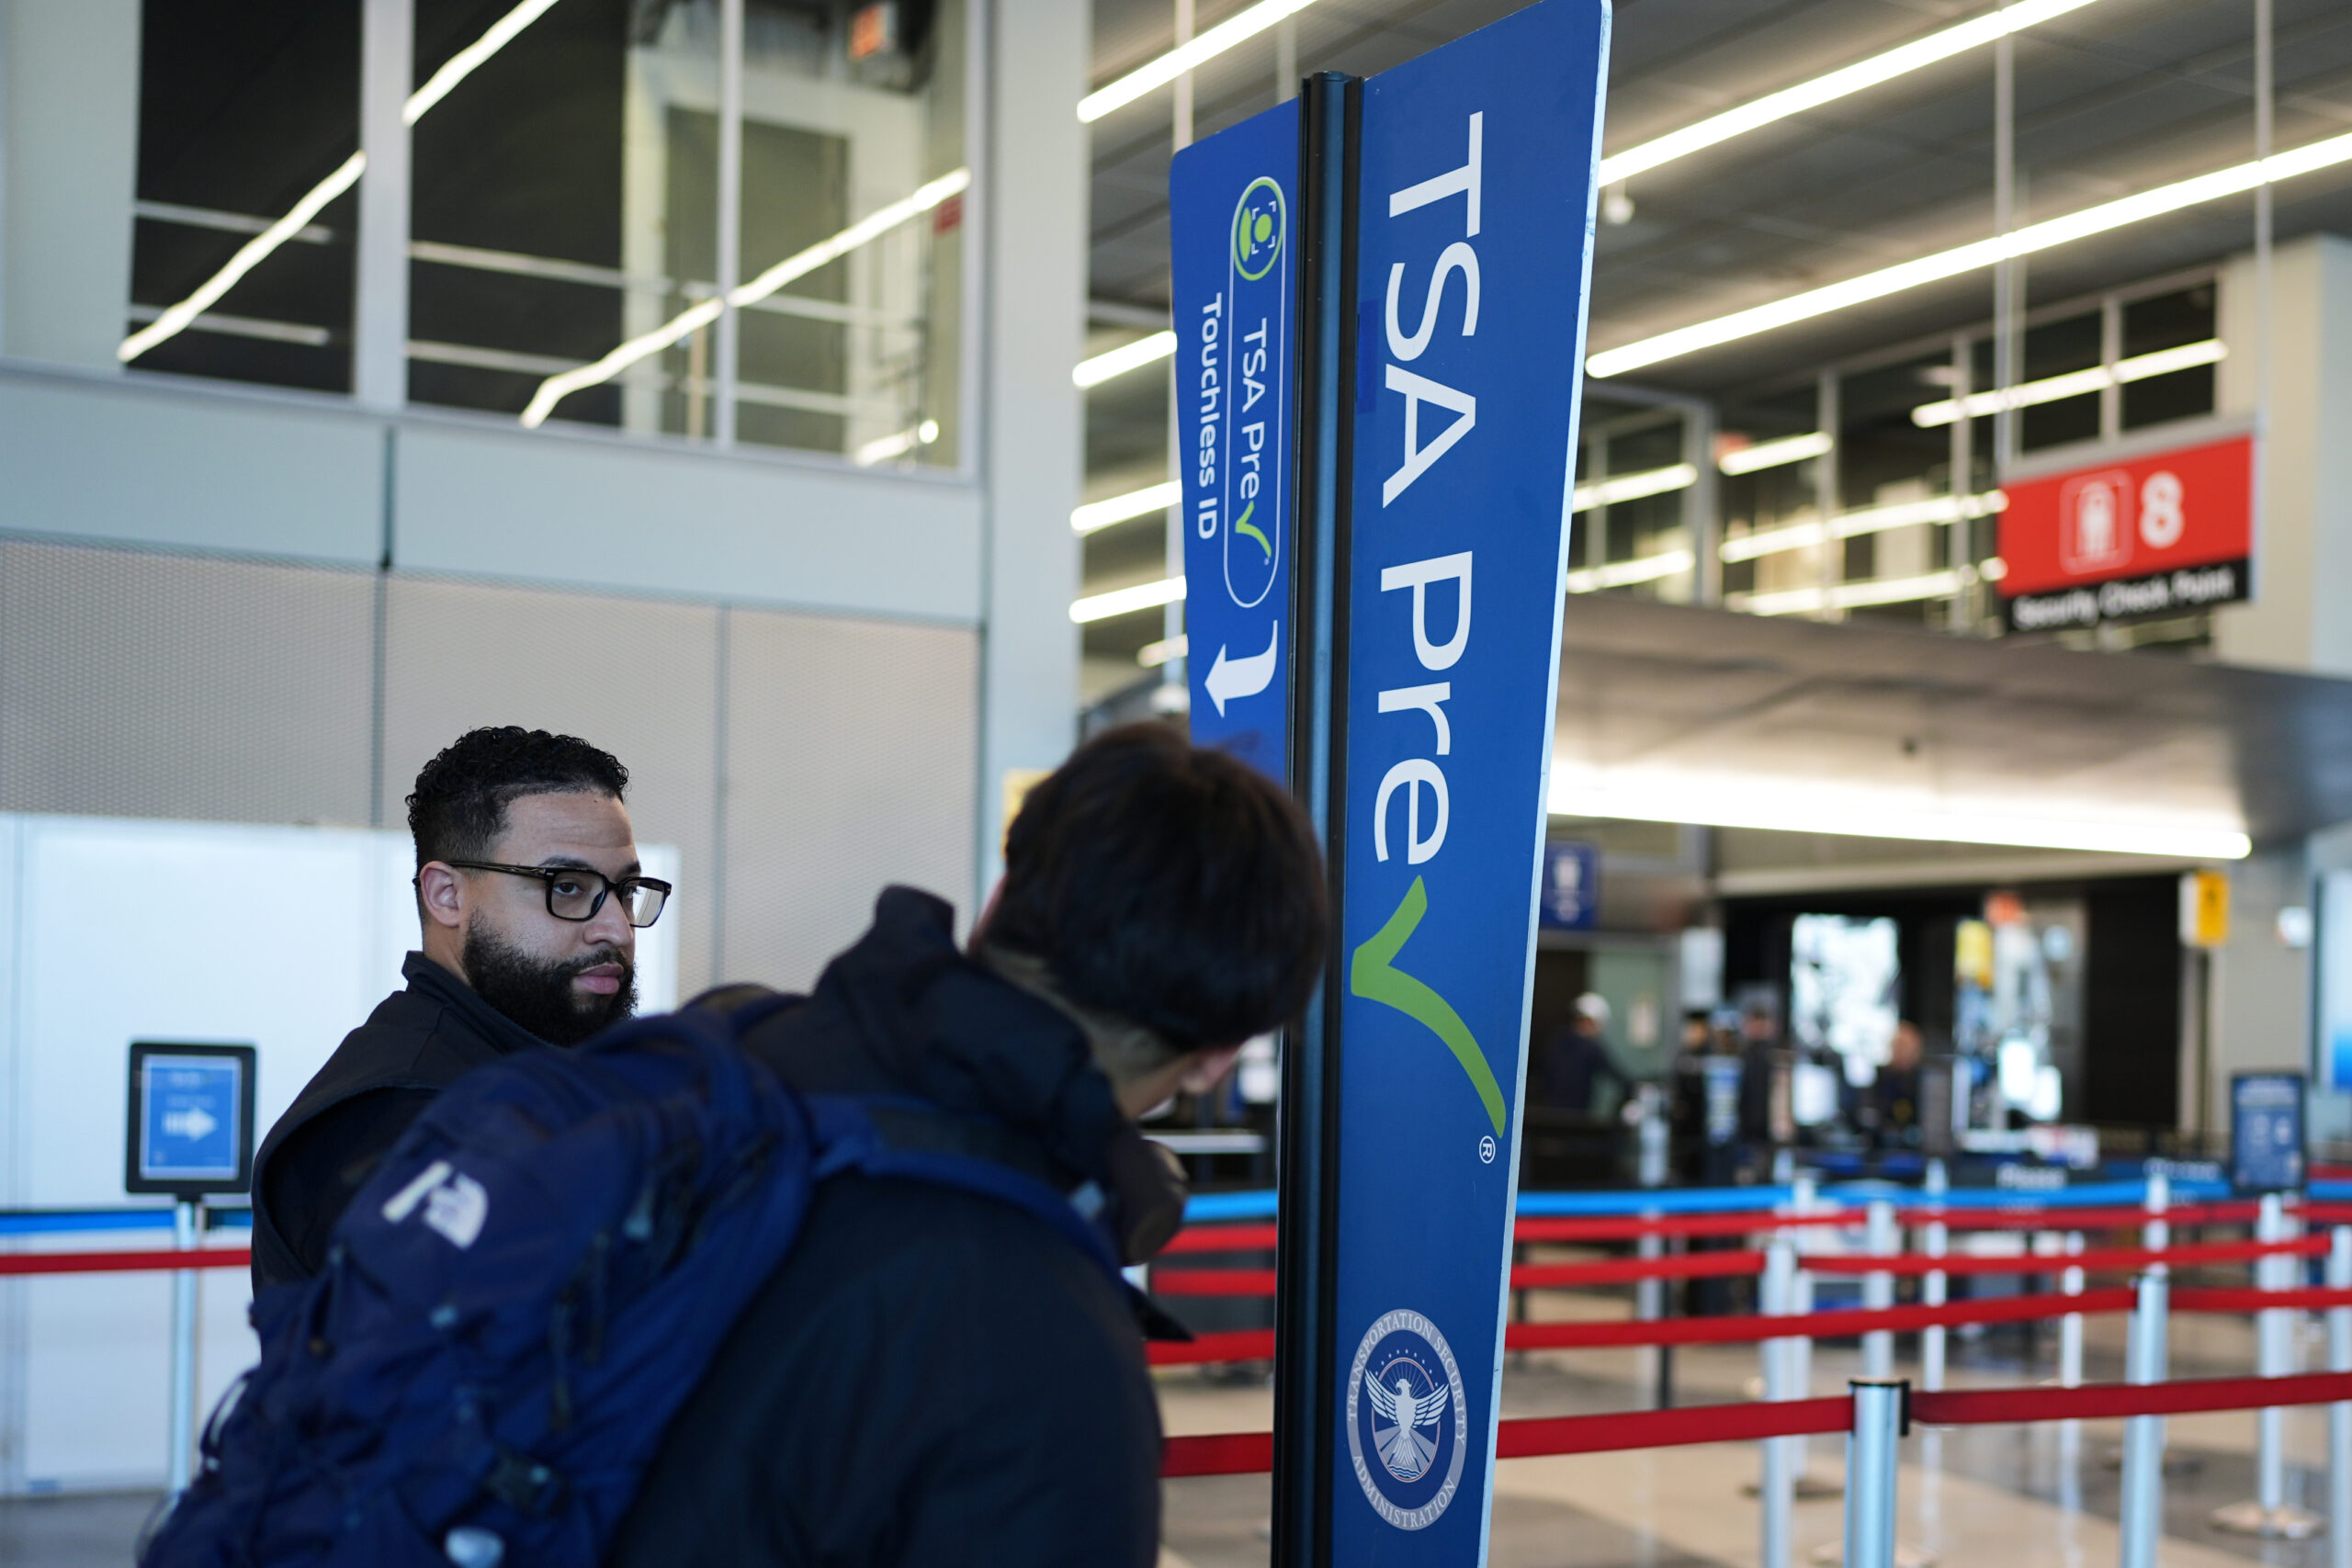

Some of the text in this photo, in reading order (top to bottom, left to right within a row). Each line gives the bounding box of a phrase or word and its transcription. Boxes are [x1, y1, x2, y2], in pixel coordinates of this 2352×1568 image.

[1383, 111, 1483, 508] TSA
[1198, 292, 1222, 539] Touchless ID
[1240, 317, 1267, 500] TSA Pre
[2139, 470, 2185, 549] 8
[2012, 567, 2233, 630] Security Check Point
[1374, 551, 1473, 864] Pre
[1348, 1312, 1466, 1446] TRANSPORTATION SECURITY
[1352, 1454, 1455, 1529] ADMINISTRATION
